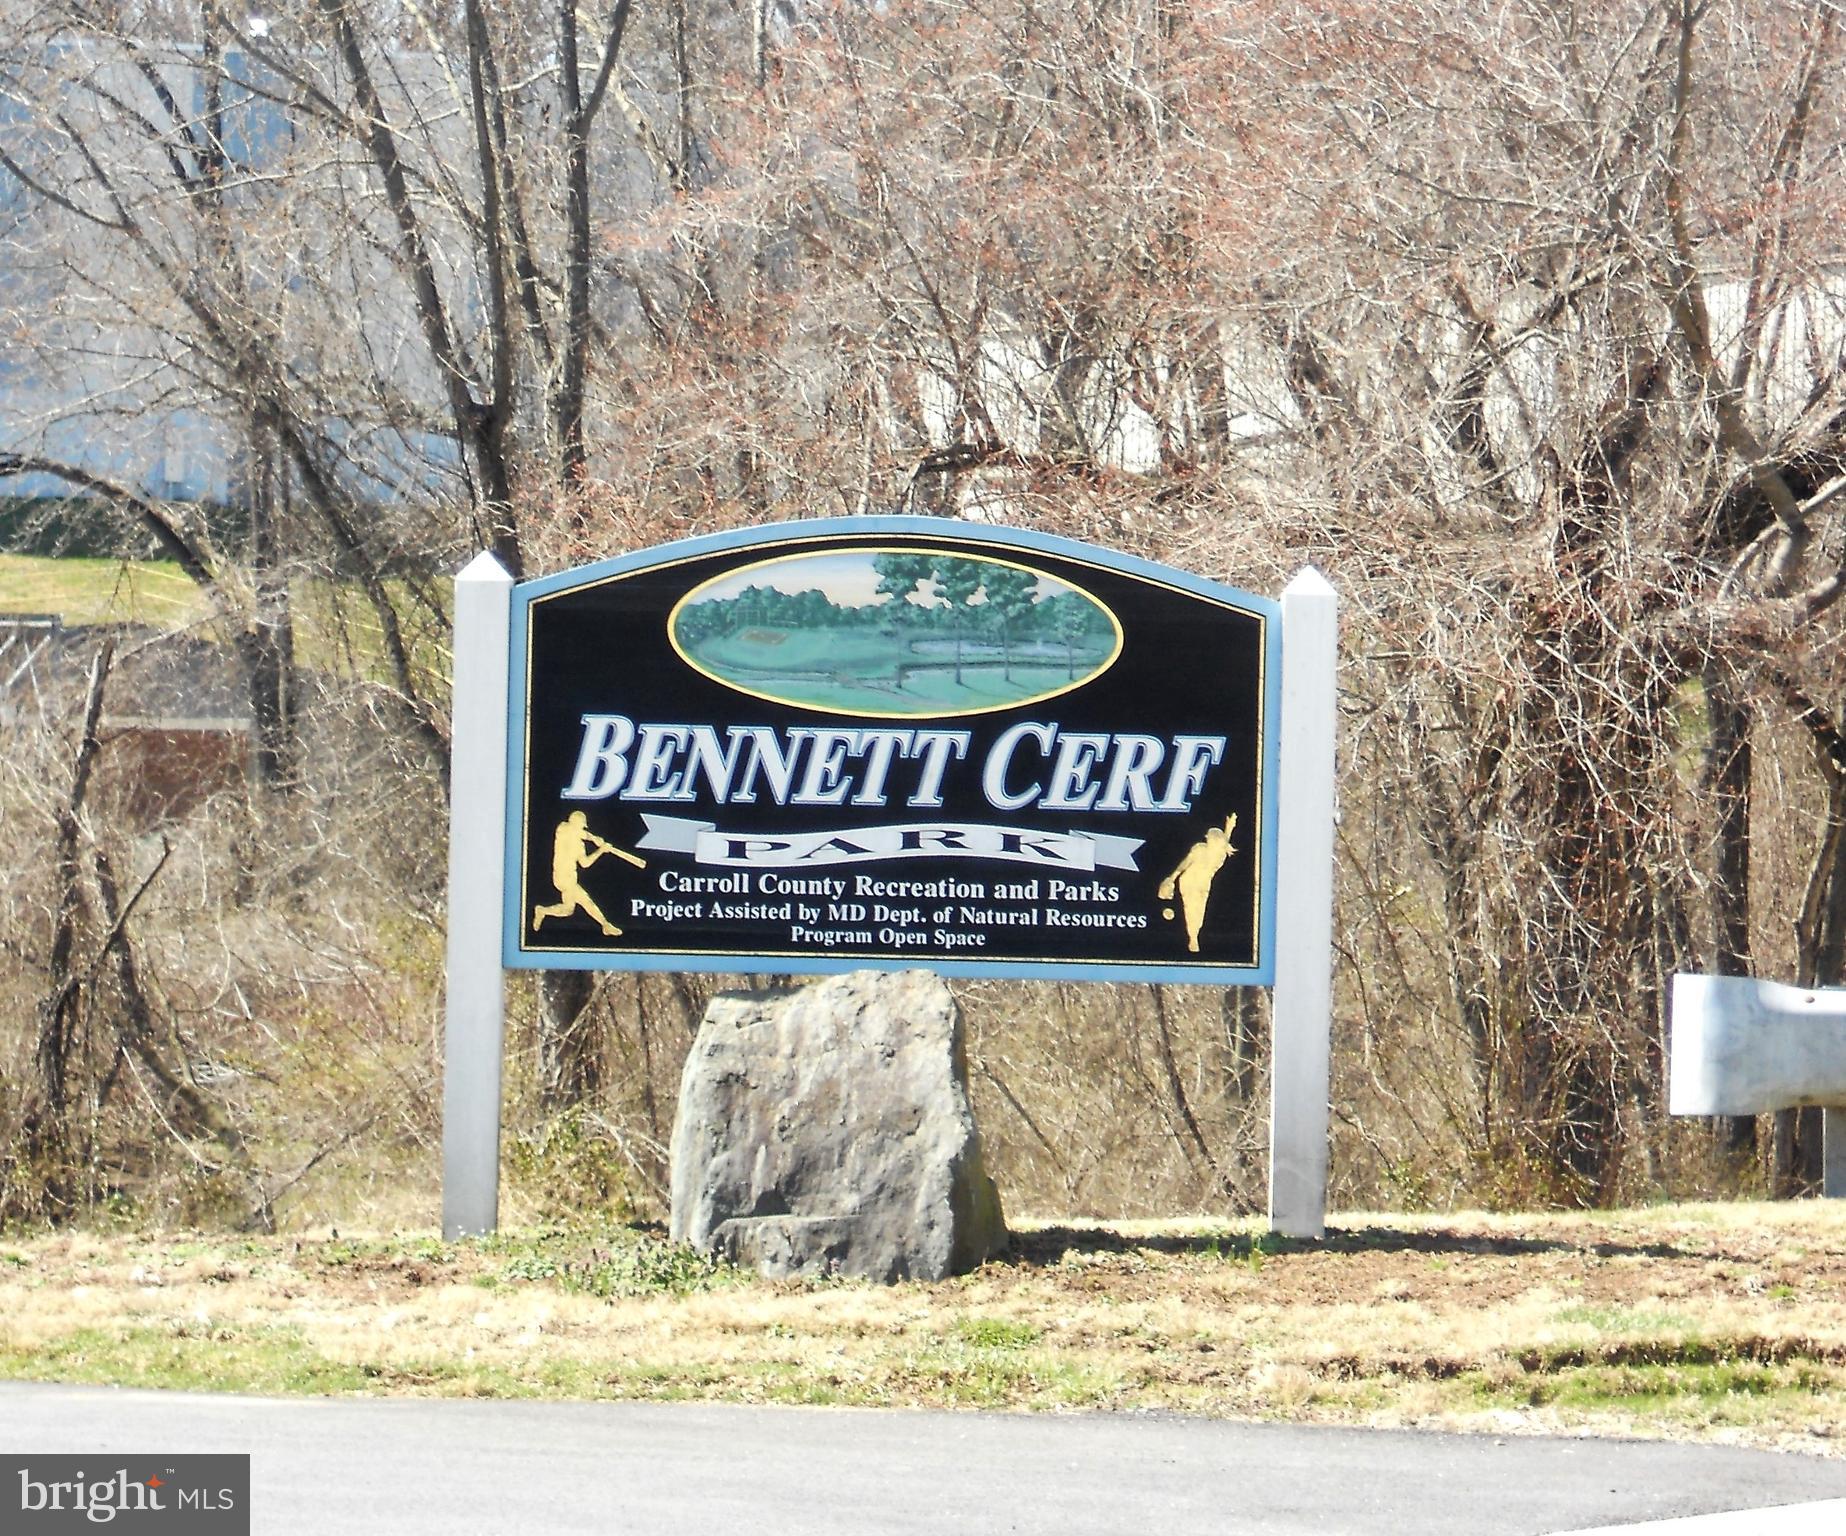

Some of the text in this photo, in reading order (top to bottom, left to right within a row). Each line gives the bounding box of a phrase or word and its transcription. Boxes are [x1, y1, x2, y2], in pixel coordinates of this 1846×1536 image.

[561, 714, 1227, 812] BENNETT CERF
[725, 830, 1070, 861] PARK
[659, 871, 1120, 901] Carroll County Recreation and Parks
[630, 899, 1148, 929] Project Assisted by MD Dept. of Natural Resources
[790, 926, 986, 949] Program Open Space
